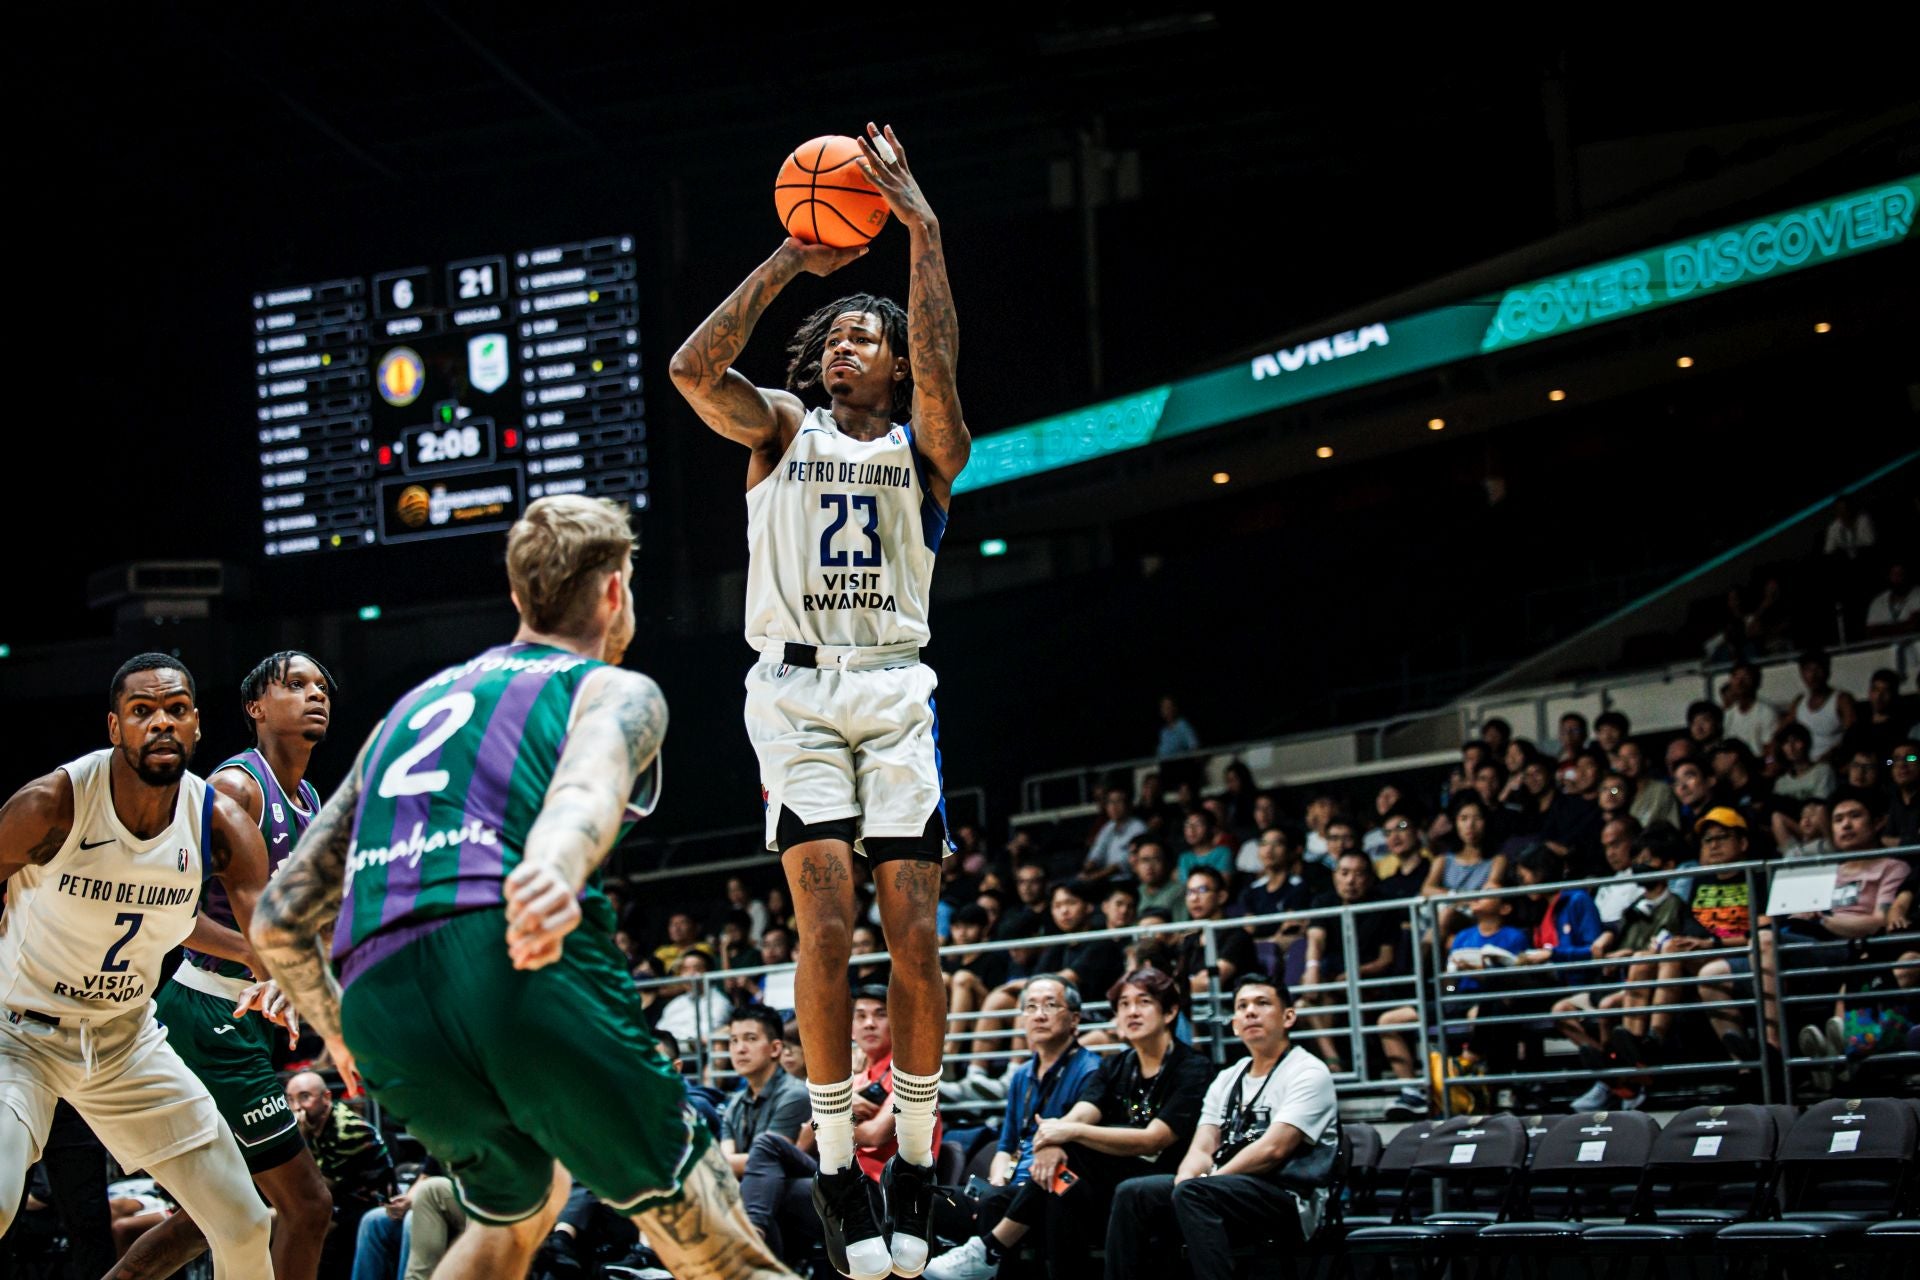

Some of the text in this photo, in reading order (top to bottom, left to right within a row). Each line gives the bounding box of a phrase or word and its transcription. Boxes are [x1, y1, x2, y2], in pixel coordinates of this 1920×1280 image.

[1663, 184, 1917, 298] DISCOVER
[392, 278, 415, 309] 6
[459, 264, 494, 299] 21
[417, 425, 482, 463] 2:08
[788, 461, 911, 489] PETRO DE LUANDA
[819, 493, 882, 567] 23
[822, 573, 880, 591] VISIT
[802, 592, 897, 613] RWANDA
[378, 691, 475, 799] 2
[57, 873, 194, 906] PETRO DE LUANDA
[100, 912, 144, 973] 2
[53, 981, 144, 1003] RWANDA
[83, 974, 138, 990] VISIT
